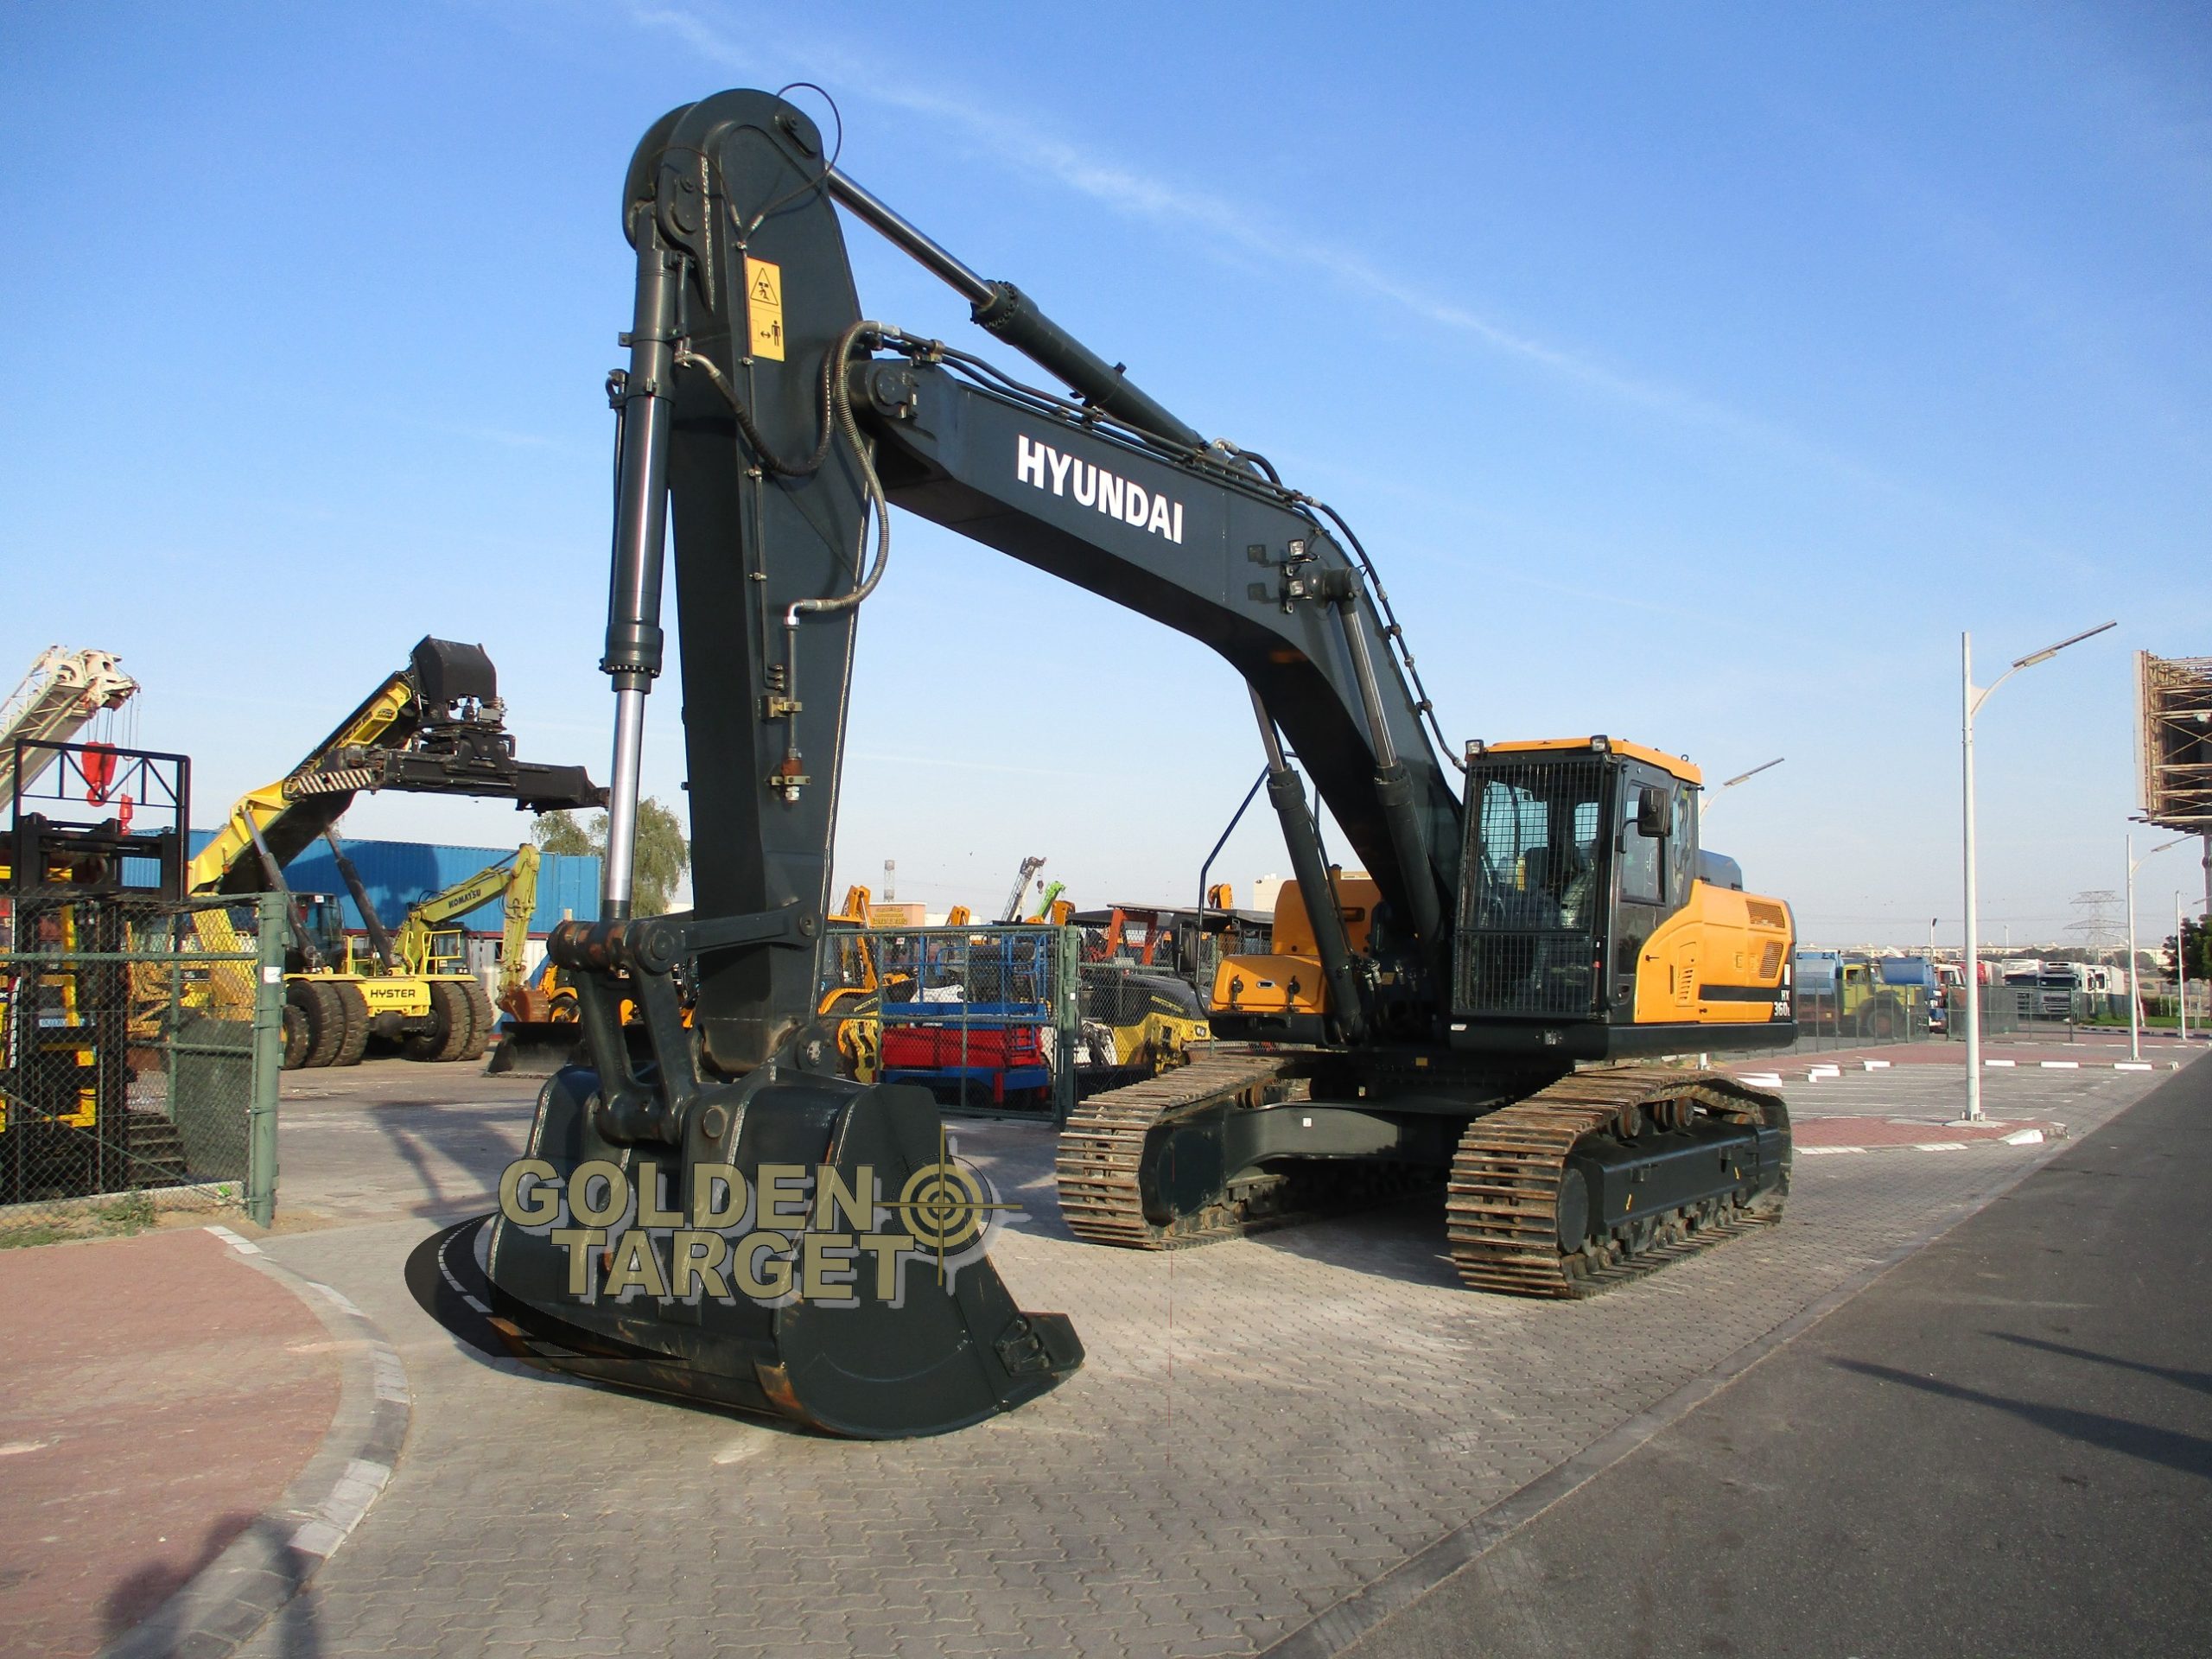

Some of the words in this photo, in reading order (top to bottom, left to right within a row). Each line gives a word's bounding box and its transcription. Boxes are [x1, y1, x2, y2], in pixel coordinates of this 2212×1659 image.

[1017, 435, 1184, 544] HYUNDAI
[448, 889, 481, 909] KOMATSU
[370, 988, 416, 998] HYSTER
[1781, 989, 1790, 1001] HX
